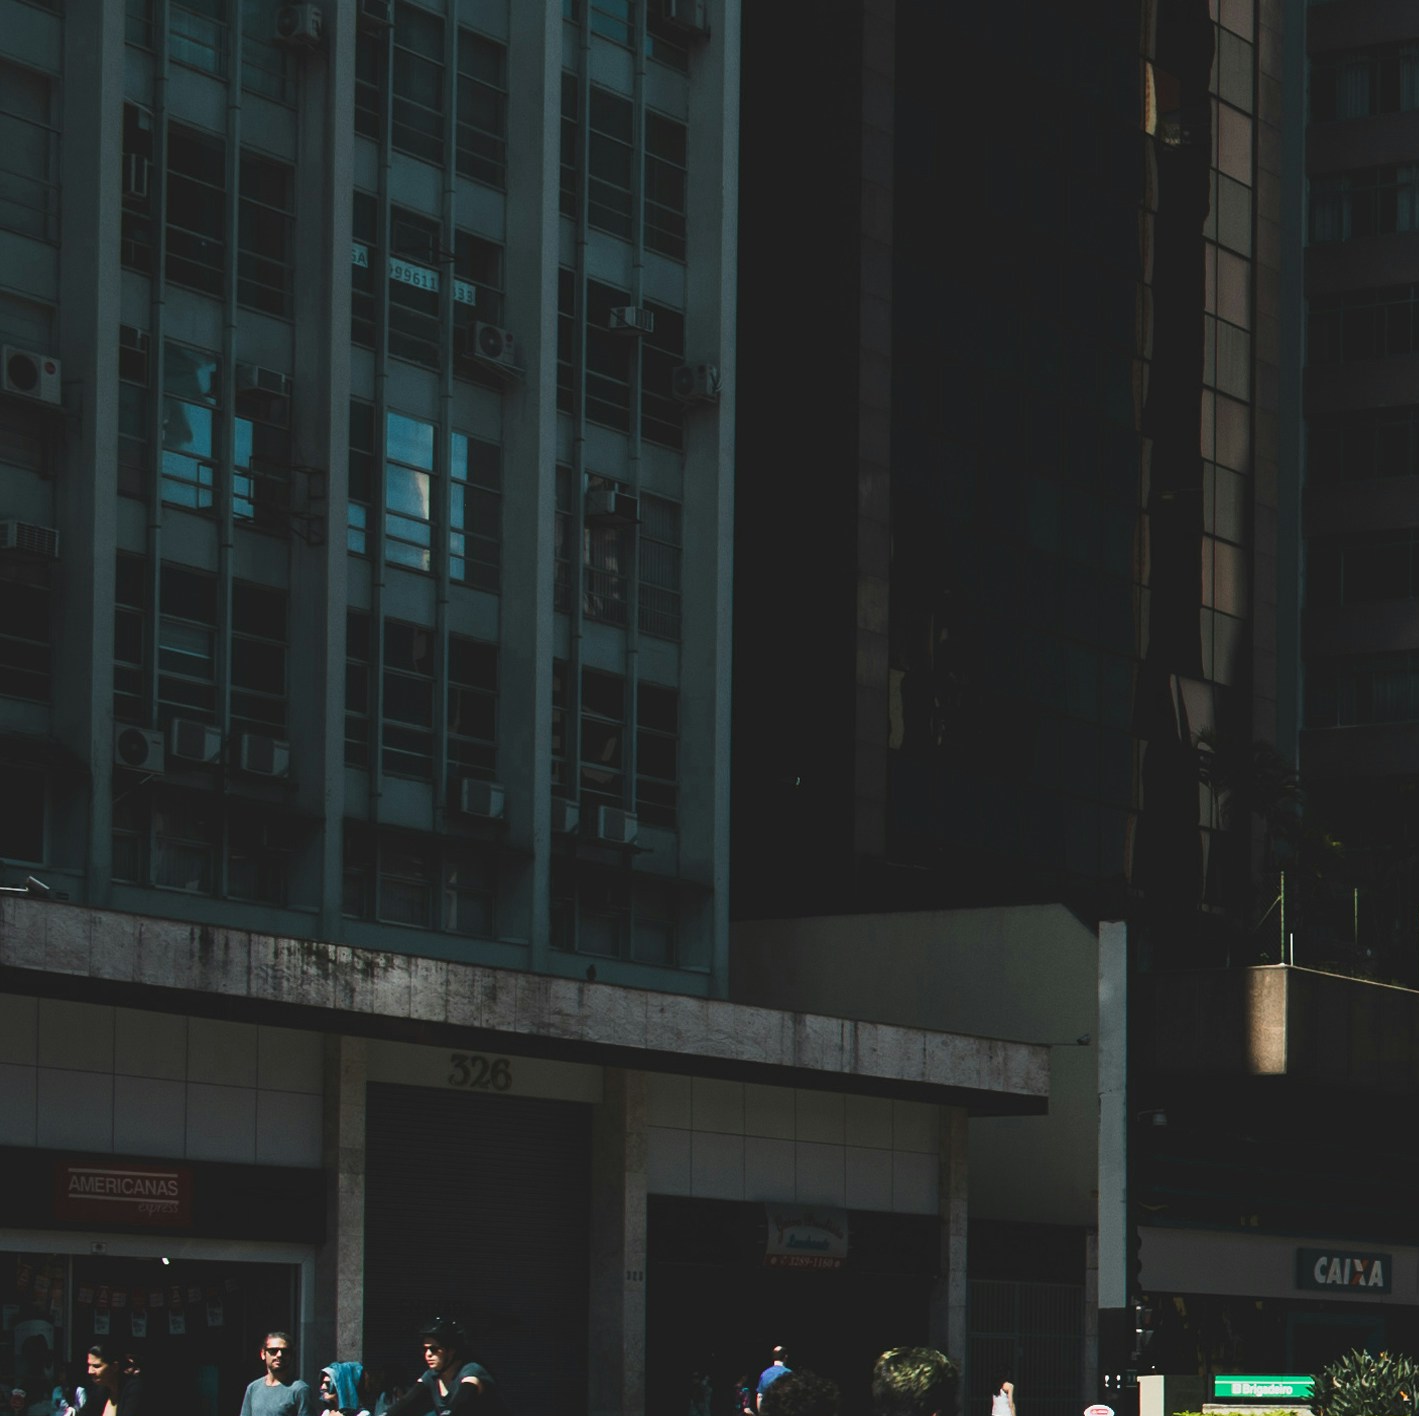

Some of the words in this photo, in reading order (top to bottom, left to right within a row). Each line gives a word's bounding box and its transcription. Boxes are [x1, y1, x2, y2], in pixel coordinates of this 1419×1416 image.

[448, 1054, 512, 1091] 326
[68, 1175, 179, 1196] AMERICANAS
[138, 1202, 179, 1216] express
[1314, 1256, 1384, 1287] CAIXA
[1242, 1383, 1293, 1397] Brigadeiro
